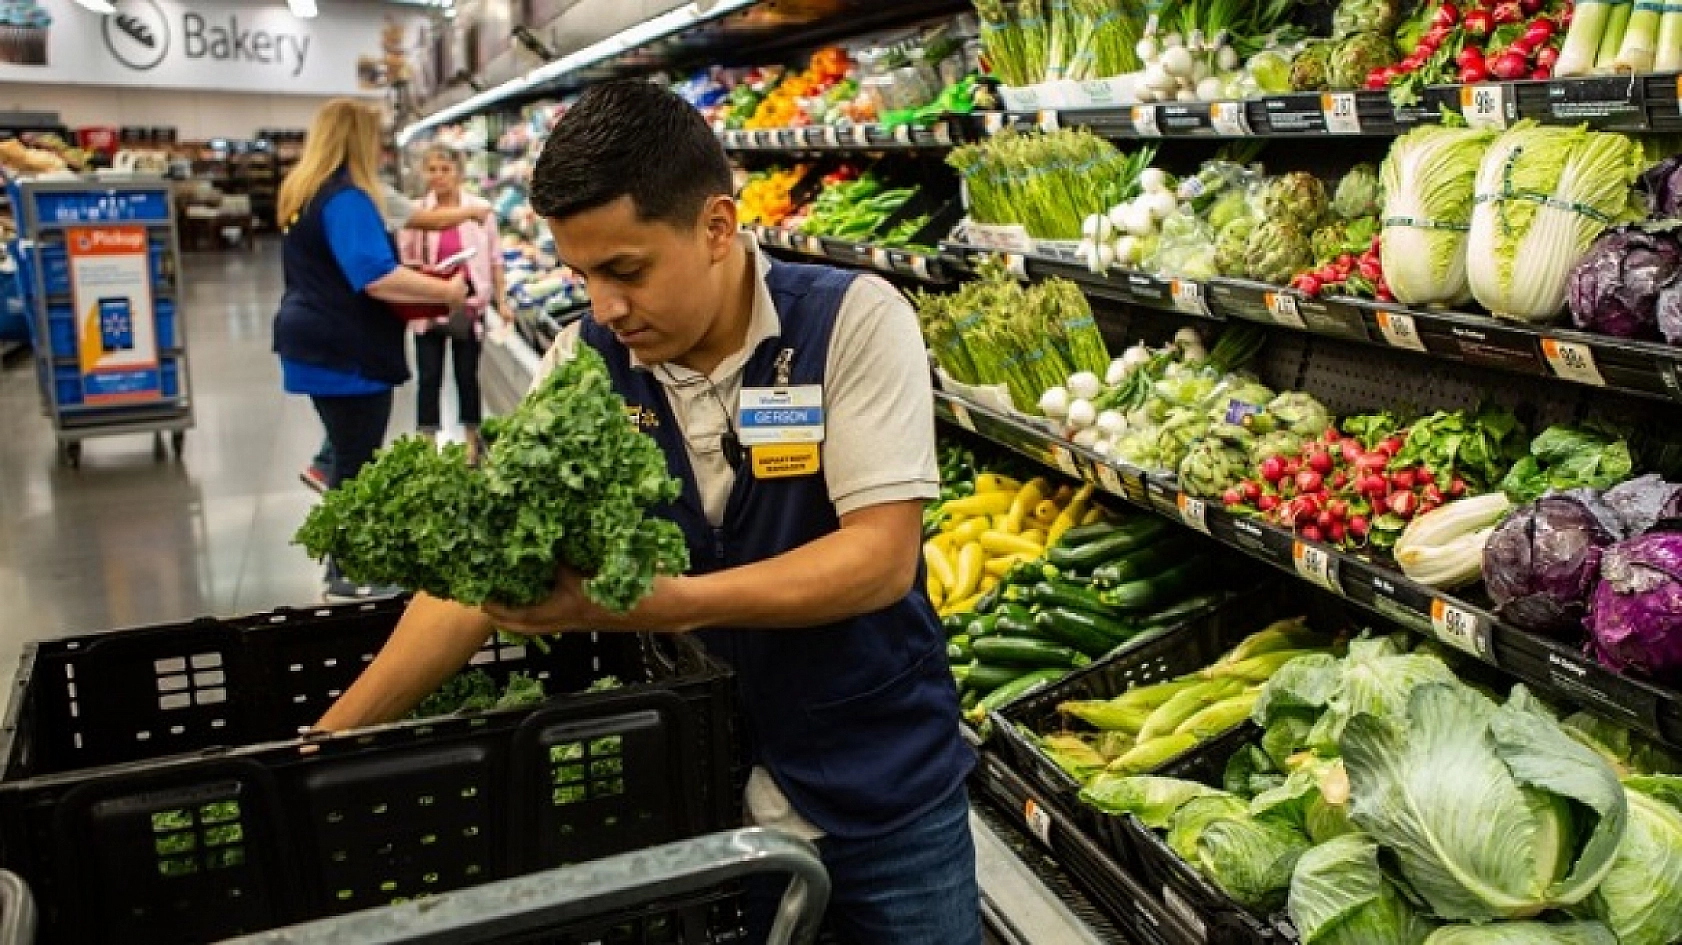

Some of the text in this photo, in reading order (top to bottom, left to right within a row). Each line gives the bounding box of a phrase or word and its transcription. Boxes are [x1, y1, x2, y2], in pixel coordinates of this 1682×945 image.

[184, 11, 311, 77] Bakery
[91, 229, 143, 249] Pickup
[754, 410, 808, 424] GERSON
